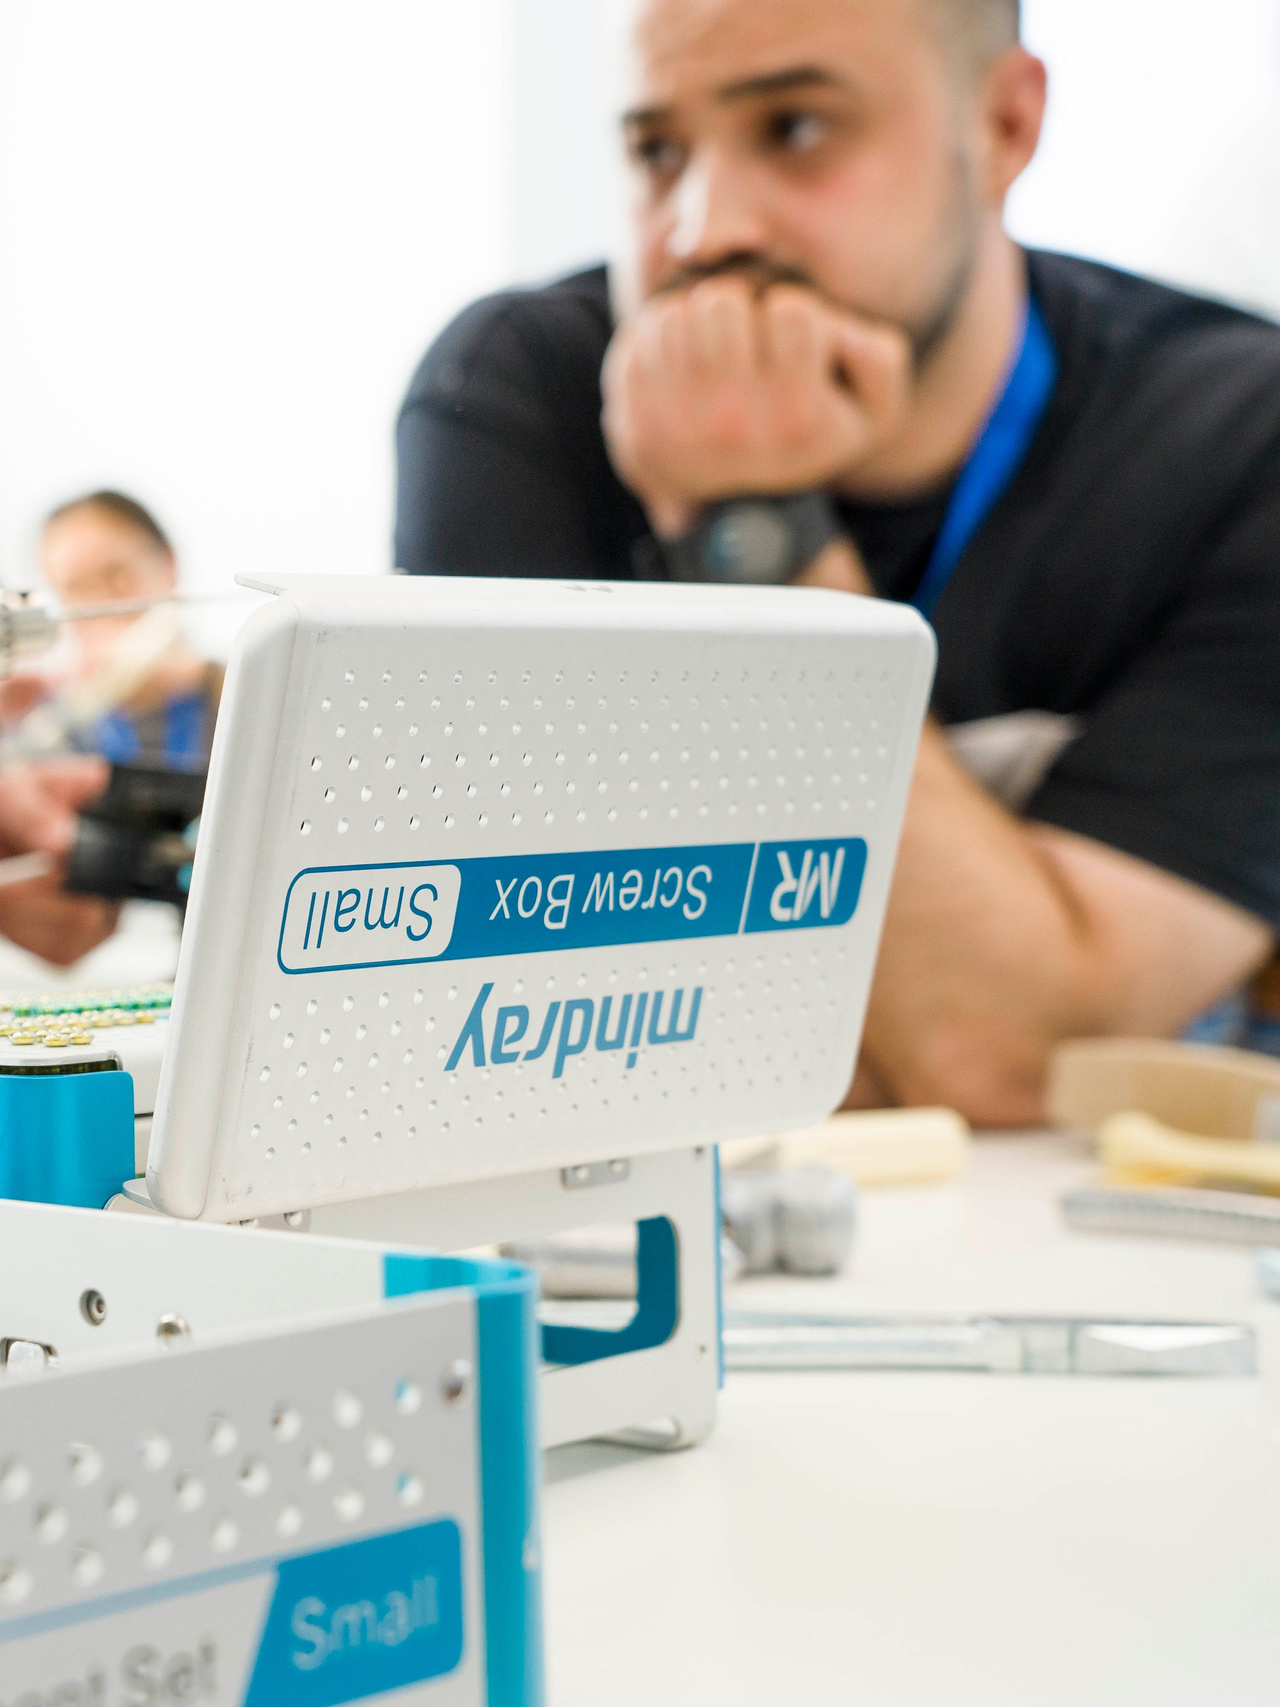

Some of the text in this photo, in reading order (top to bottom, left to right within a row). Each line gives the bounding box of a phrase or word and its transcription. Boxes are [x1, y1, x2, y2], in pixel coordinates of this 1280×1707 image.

[302, 847, 845, 950] MR Screw Box Small
[443, 982, 703, 1079] mindray
[290, 1575, 439, 1671] Small
